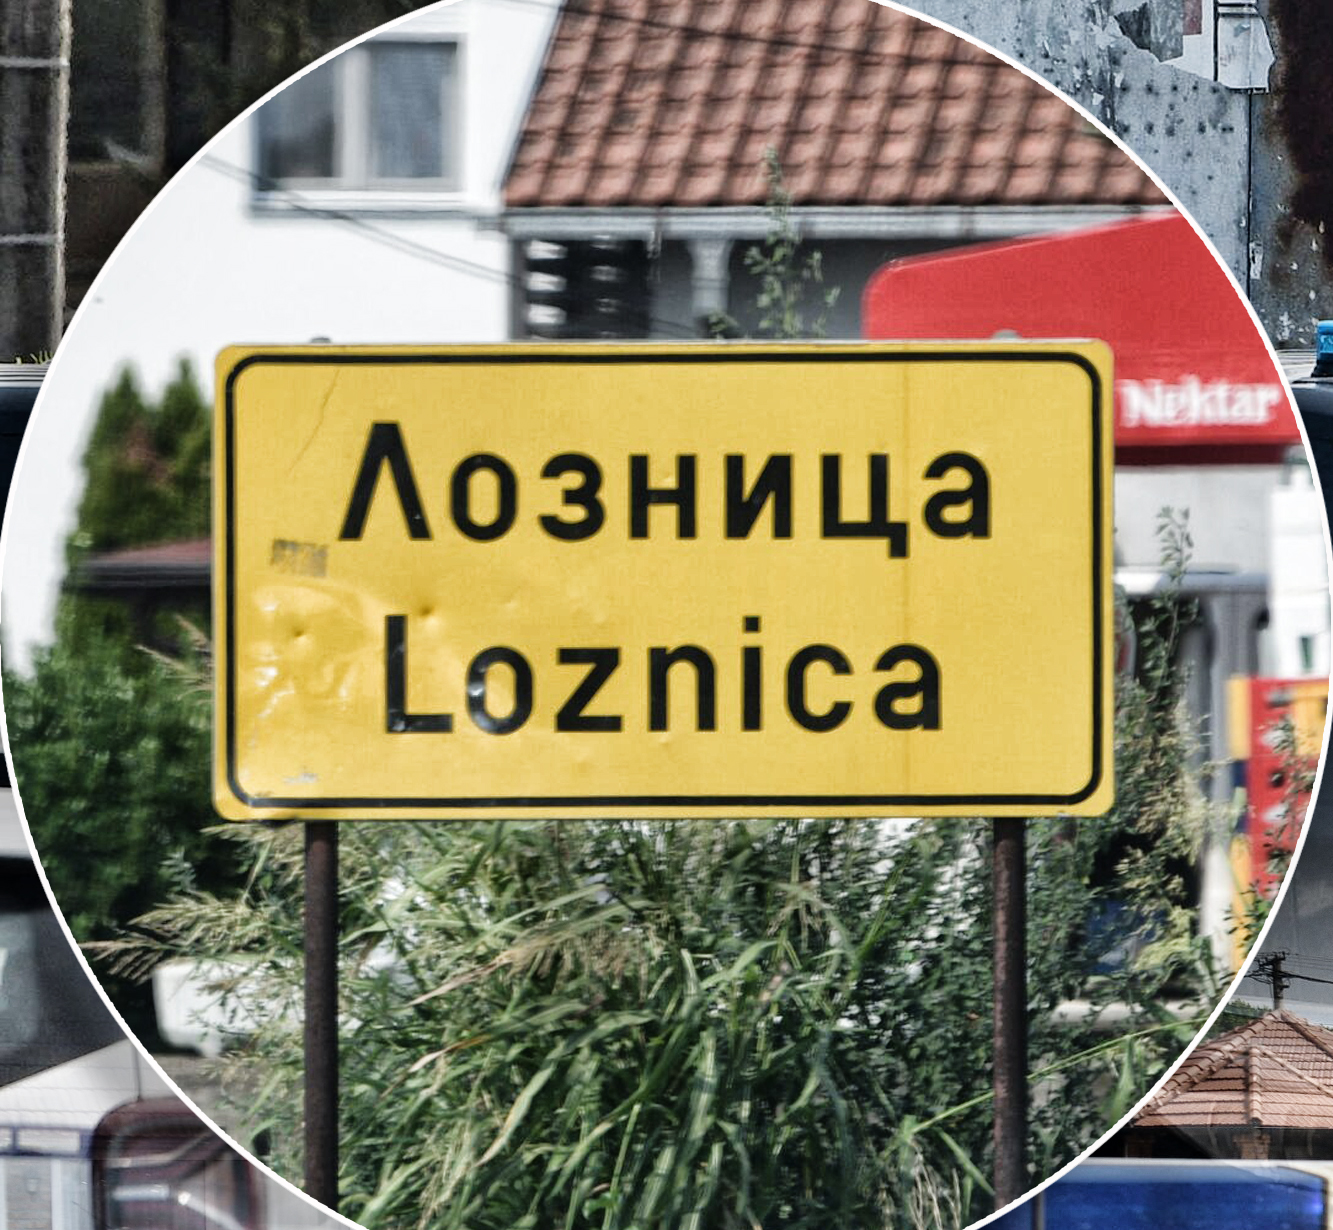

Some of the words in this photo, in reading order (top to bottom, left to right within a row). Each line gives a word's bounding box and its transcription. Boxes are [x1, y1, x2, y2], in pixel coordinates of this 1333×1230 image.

[1114, 374, 1283, 429] Nektar
[337, 420, 994, 560] Лозница
[383, 613, 945, 735] Loznica
